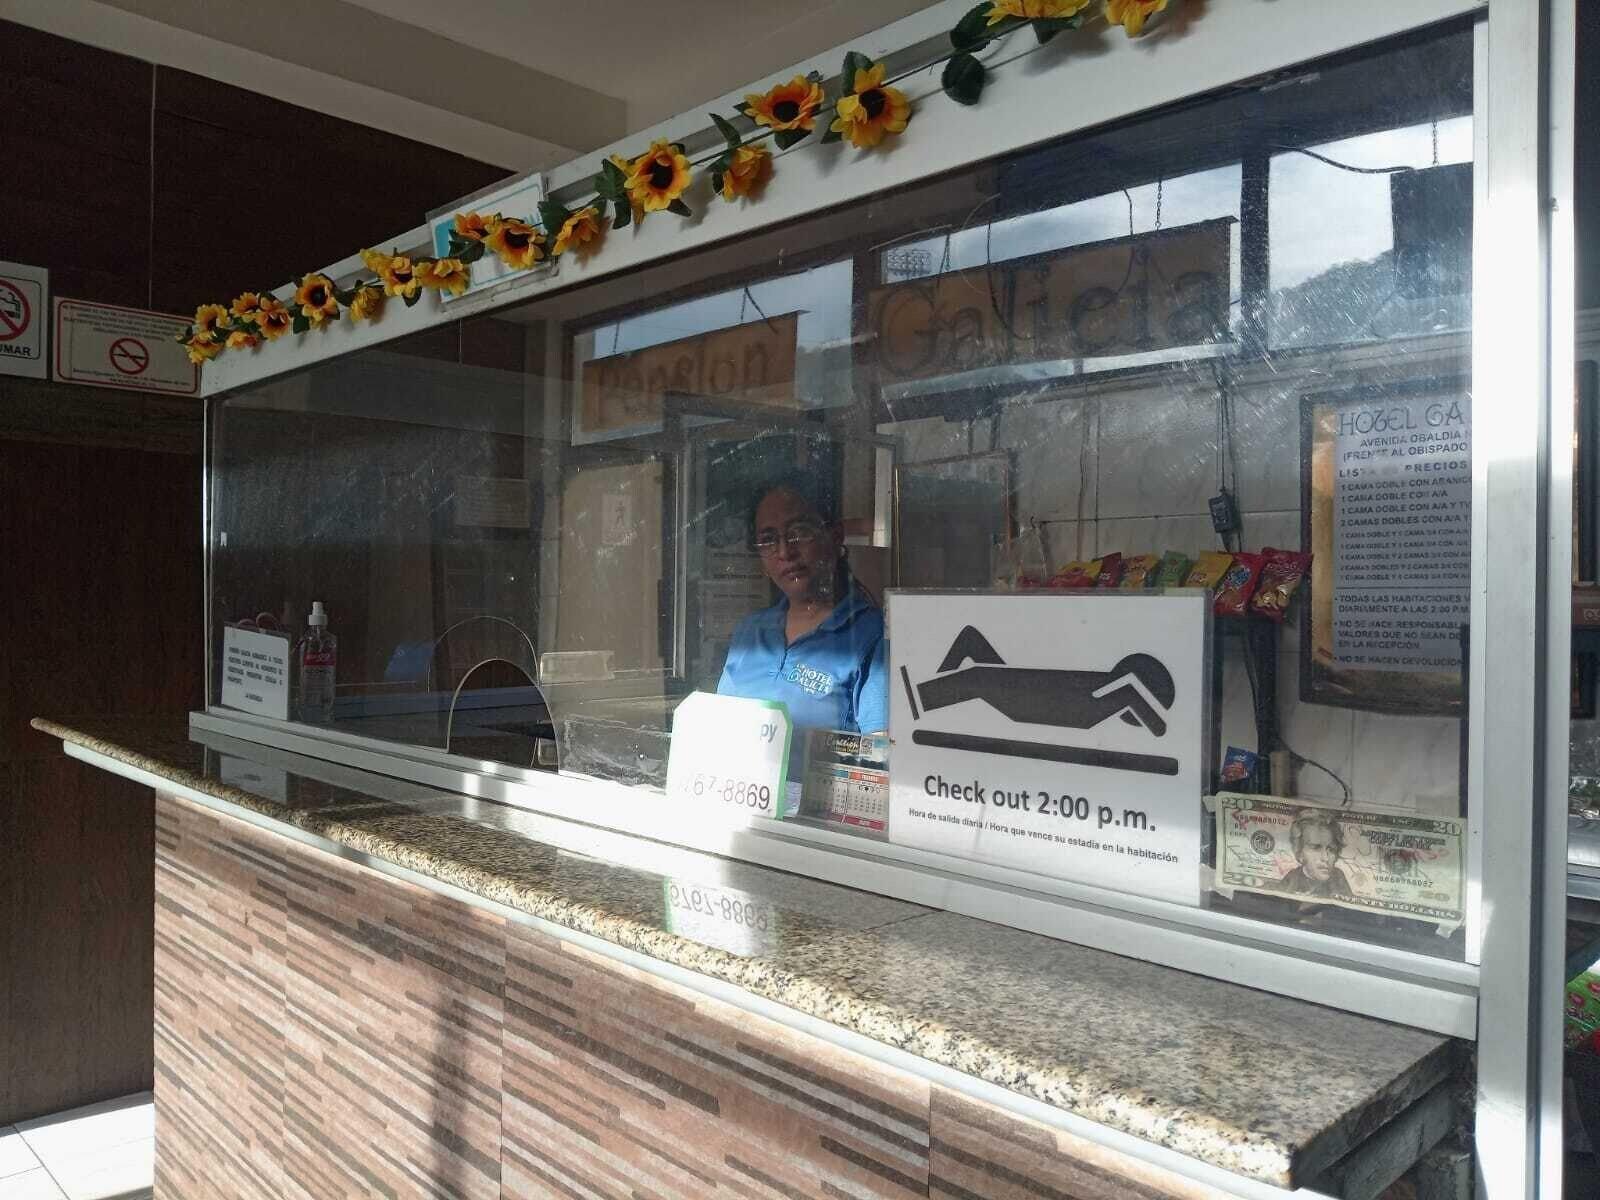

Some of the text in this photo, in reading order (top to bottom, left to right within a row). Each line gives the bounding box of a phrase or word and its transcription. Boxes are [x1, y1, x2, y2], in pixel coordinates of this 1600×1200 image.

[1360, 437, 1407, 449] AVENIDA
[1391, 448, 1406, 457] AL
[1408, 442, 1468, 457] OBISPADO
[1404, 460, 1468, 474] PRECIOS
[1347, 504, 1374, 514] CAMA
[1347, 517, 1379, 526] CAMAS
[924, 774, 1158, 832] Check out 2:00 p.m.
[908, 807, 926, 818] Hora
[927, 810, 937, 820] de
[938, 812, 960, 825] salida
[961, 816, 983, 829] diaria
[990, 822, 1010, 834] Hora
[1010, 827, 1026, 838] que
[1027, 830, 1053, 842] vence
[1054, 834, 1066, 844] su
[1102, 844, 1114, 853] en
[1116, 843, 1125, 854] la
[1126, 846, 1179, 863] habitación
